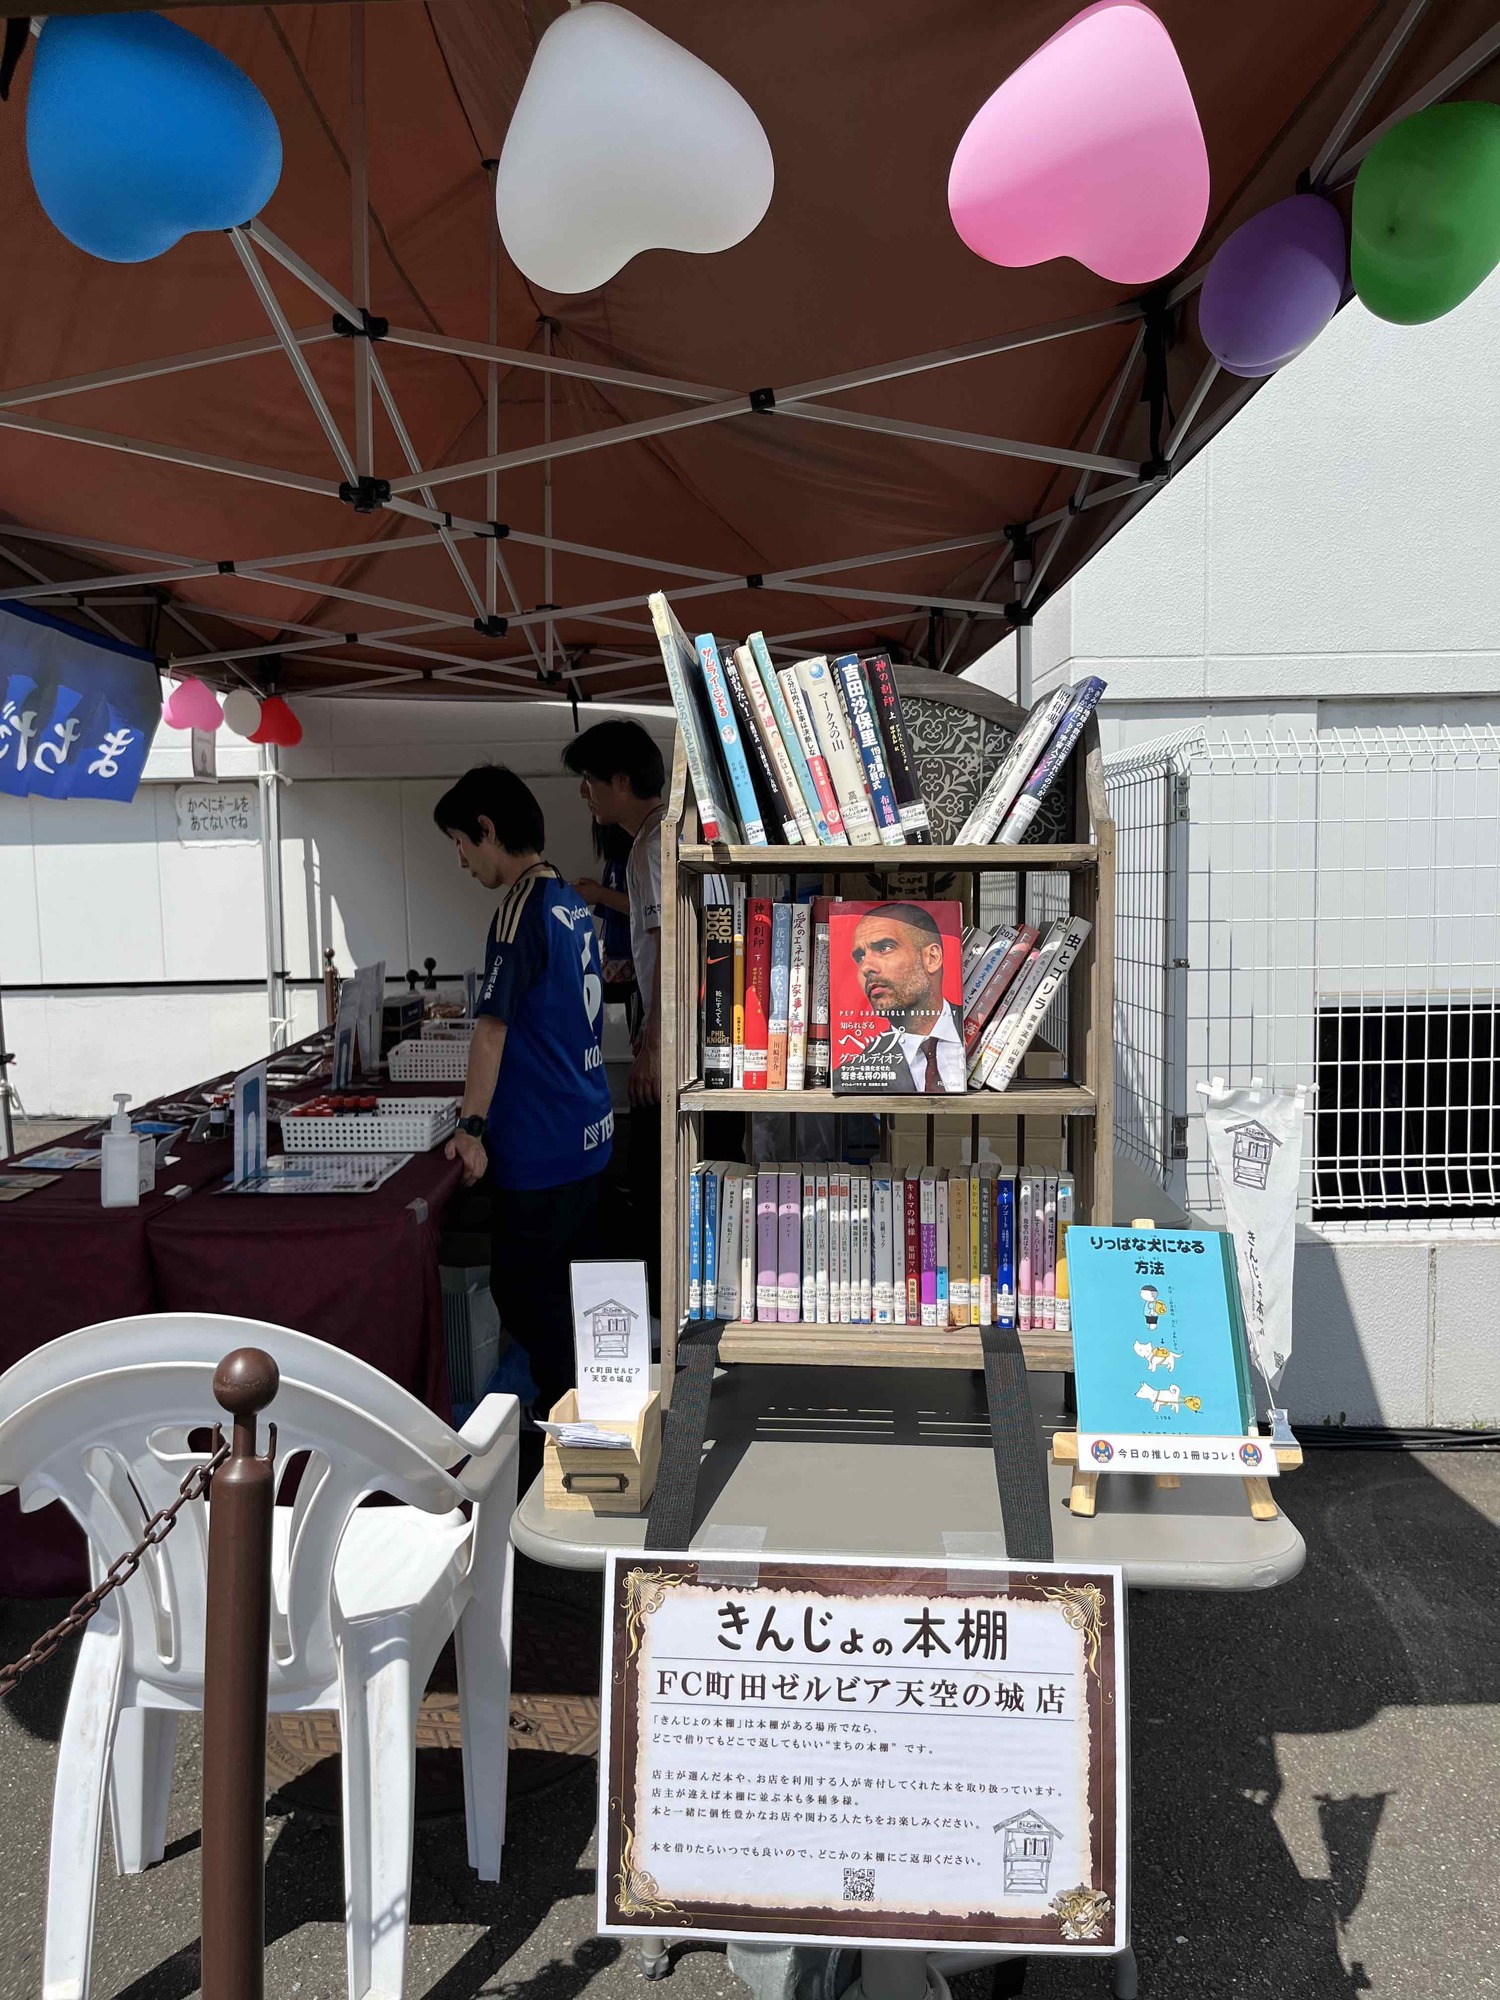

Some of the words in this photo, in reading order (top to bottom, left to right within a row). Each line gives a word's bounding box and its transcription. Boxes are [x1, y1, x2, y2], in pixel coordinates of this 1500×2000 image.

[875, 660, 895, 707] 神の刻印
[888, 711, 897, 720] 上
[842, 663, 878, 748] 吉田沙保里
[1045, 689, 1071, 725] 昭和魂
[819, 691, 845, 752] マークスの山
[867, 763, 882, 791] 方程式
[187, 796, 250, 814] かべにボールを
[190, 815, 248, 831] あてないでね
[706, 910, 720, 941] DOG
[718, 907, 732, 944] SHOE
[752, 903, 764, 948] 神の刻印
[1000, 928, 1017, 942] 2027
[754, 953, 761, 962] 下
[791, 910, 807, 1012] 愛のエネルギー家事
[1034, 933, 1082, 1010] 虫とゴリラ
[840, 1021, 876, 1030] 知られざる
[1017, 1014, 1040, 1047] 養老孟司
[706, 1036, 730, 1044] KNIGHT
[838, 1053, 904, 1065] グアルディオラ
[840, 1071, 897, 1081] 若き名将の肖像
[906, 1183, 916, 1236] キネマの神様
[1090, 1235, 1206, 1255] りっぱな犬になる
[908, 1245, 917, 1273] 原田マハ
[1133, 1260, 1166, 1276] 方法
[908, 1280, 917, 1321] 映画化話題作
[583, 1366, 641, 1375] FC町田ゼルビア
[591, 1374, 633, 1383] 天空の城店
[717, 1600, 1008, 1661] きんじょの本棚
[653, 1714, 878, 1735] 「きんじょの本棚」は本棚がある場所でなら、
[651, 1786, 859, 1806] 店主が違えば本棚に並ぶ本も多種多様。
[650, 1841, 982, 1866] 本を借りたらいつでも良いので、どこかの本棚にご返却ください。
